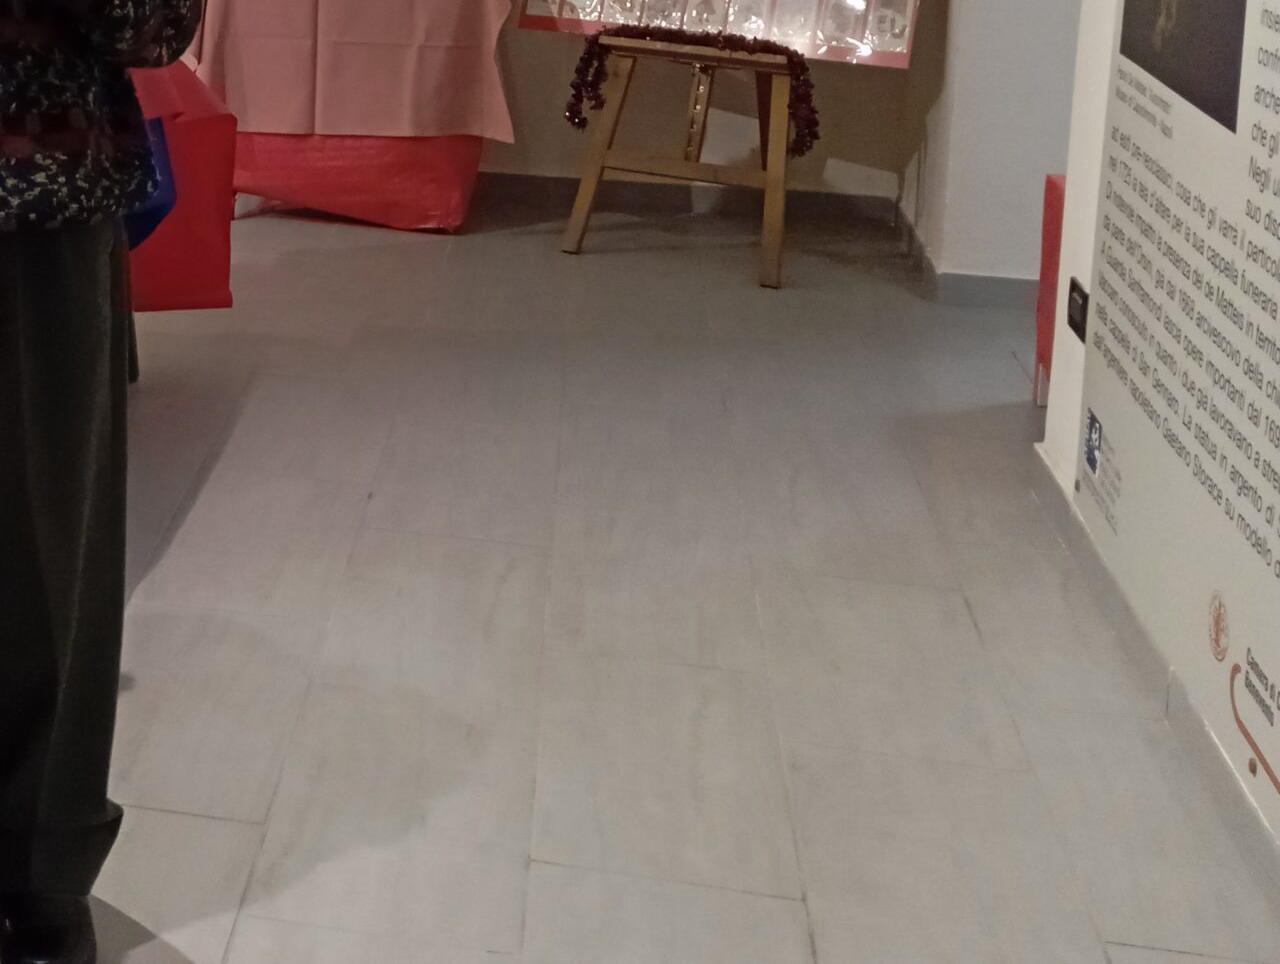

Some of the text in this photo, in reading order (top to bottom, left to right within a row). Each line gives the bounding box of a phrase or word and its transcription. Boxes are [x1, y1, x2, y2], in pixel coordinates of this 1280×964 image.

[1251, 120, 1267, 147] che
[1192, 195, 1206, 219] che
[1245, 198, 1261, 224] suo
[1215, 286, 1244, 331] Matteis
[1183, 335, 1204, 368] opere
[1205, 360, 1245, 411] importanti
[1247, 401, 1262, 428] dal
[1242, 357, 1264, 391] della
[1181, 371, 1196, 397] due
[1209, 398, 1253, 460] lavoravano
[1253, 450, 1261, 469] a
[1182, 405, 1193, 432] La
[1194, 423, 1217, 461] statua
[1219, 452, 1228, 473] in
[1229, 465, 1263, 513] argento
[1265, 504, 1275, 527] di
[1162, 417, 1191, 467] Gaetano
[1192, 454, 1223, 506] Storace
[1224, 497, 1235, 521] su
[1236, 513, 1272, 567] modello
